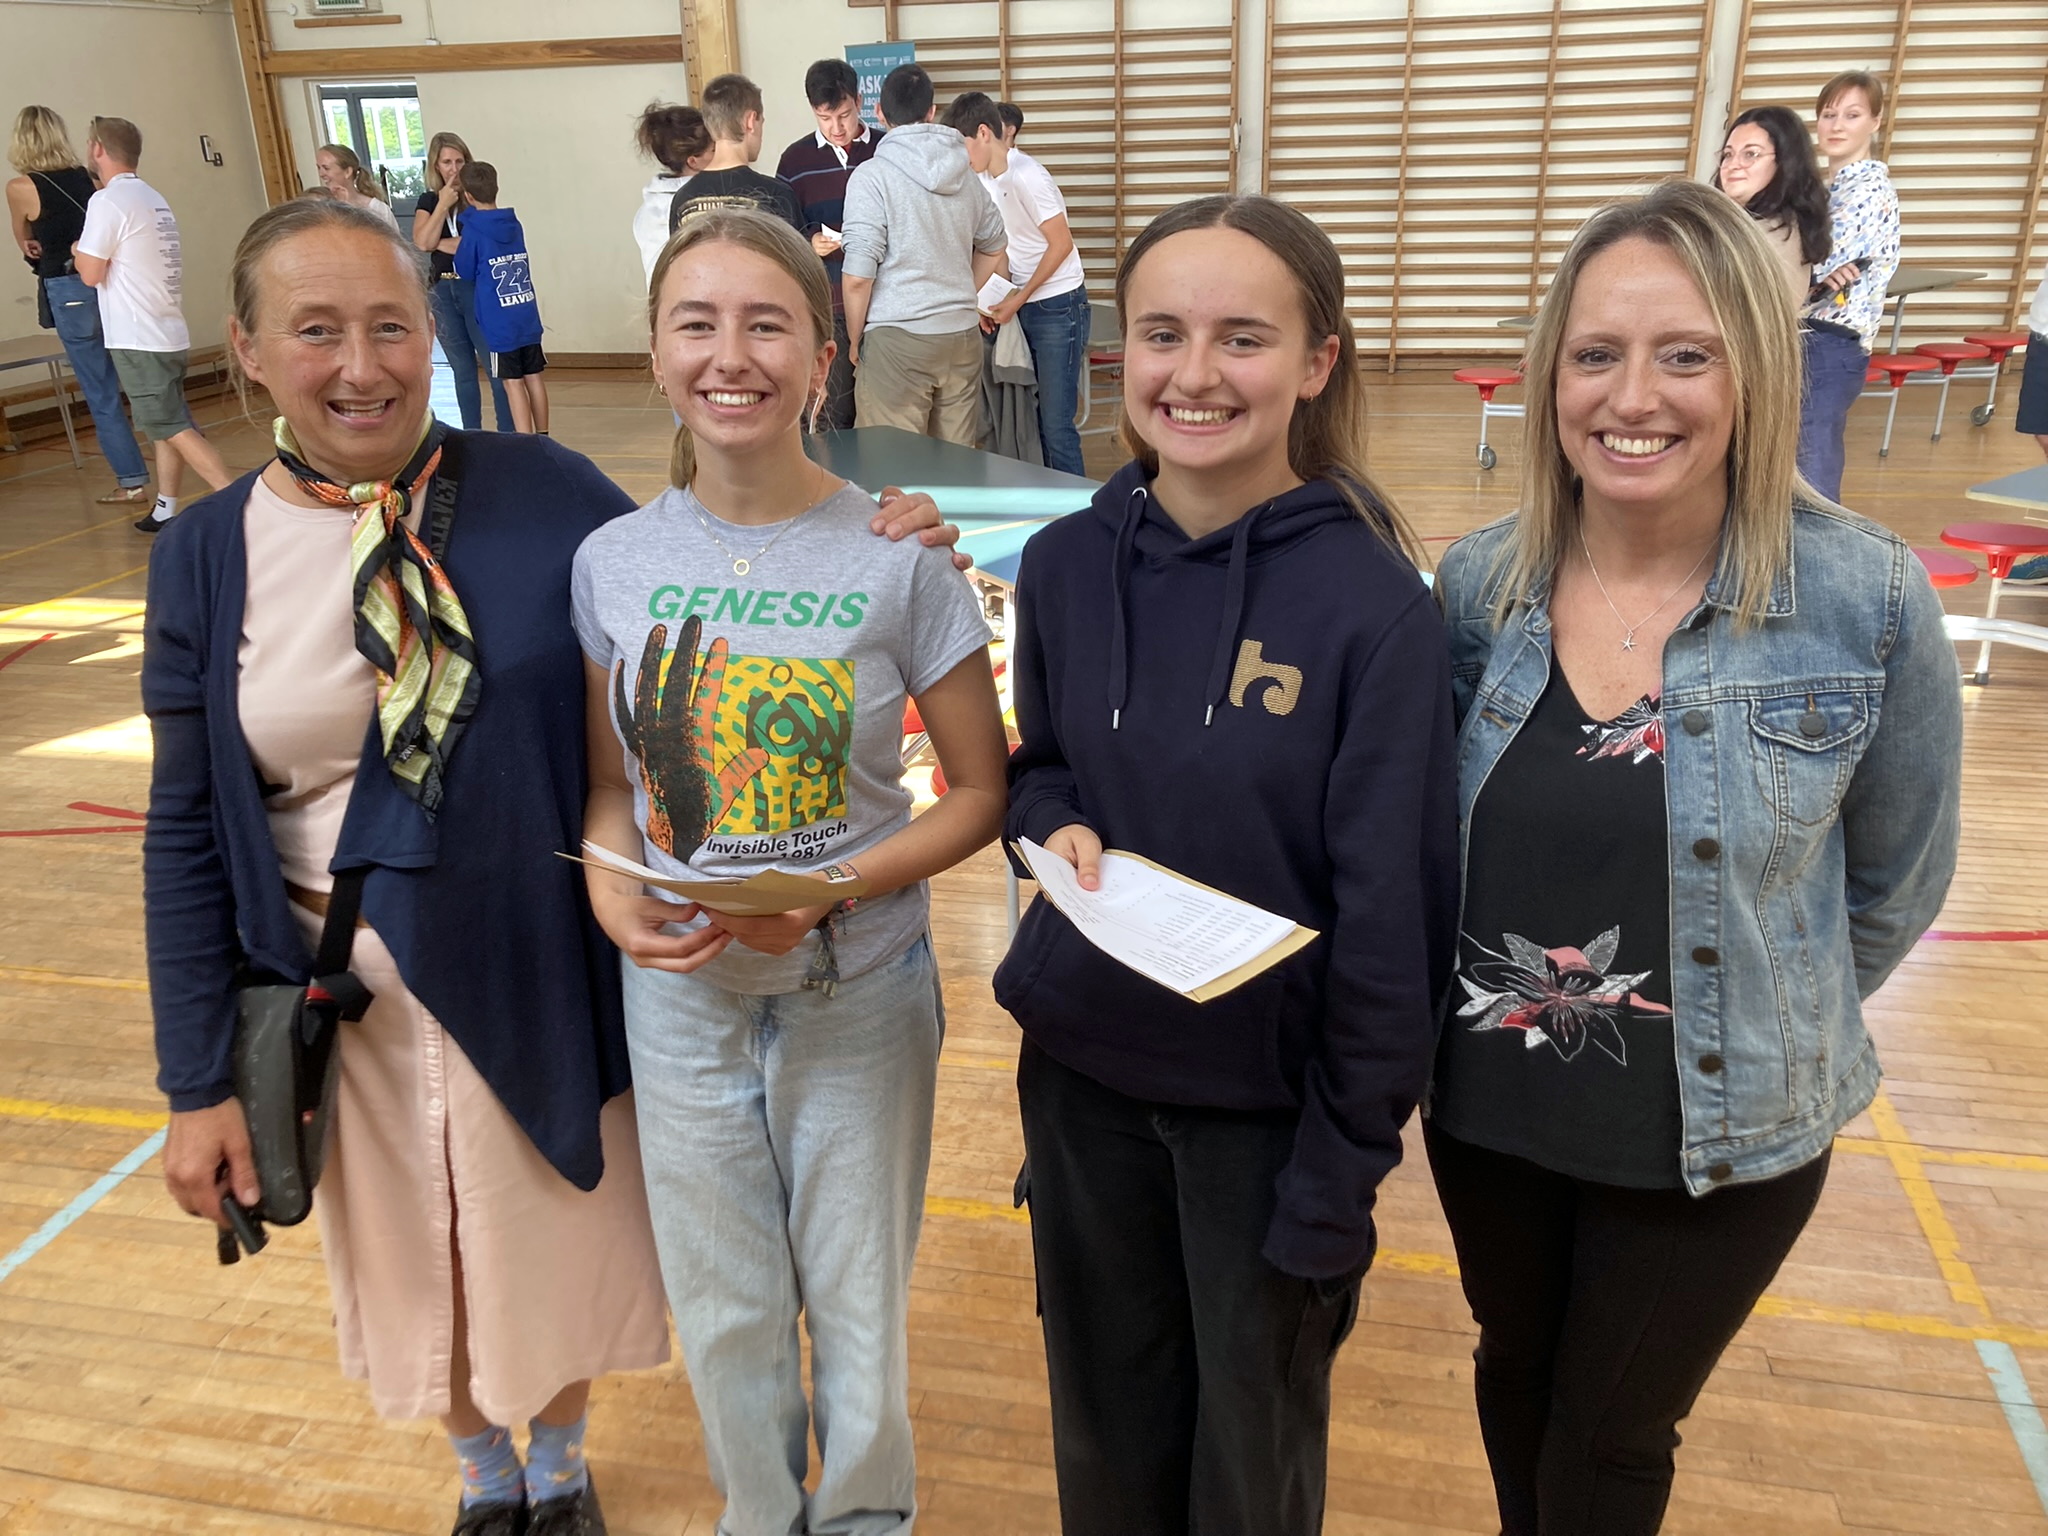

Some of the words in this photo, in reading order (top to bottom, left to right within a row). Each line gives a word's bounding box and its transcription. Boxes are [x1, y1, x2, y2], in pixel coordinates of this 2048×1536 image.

[859, 75, 881, 94] ASK
[864, 97, 881, 105] ABOU
[491, 259, 532, 298] 22
[648, 584, 869, 629] GENESIS
[706, 837, 788, 855] Invisible
[791, 821, 848, 848] Touch
[779, 842, 827, 859] 987
